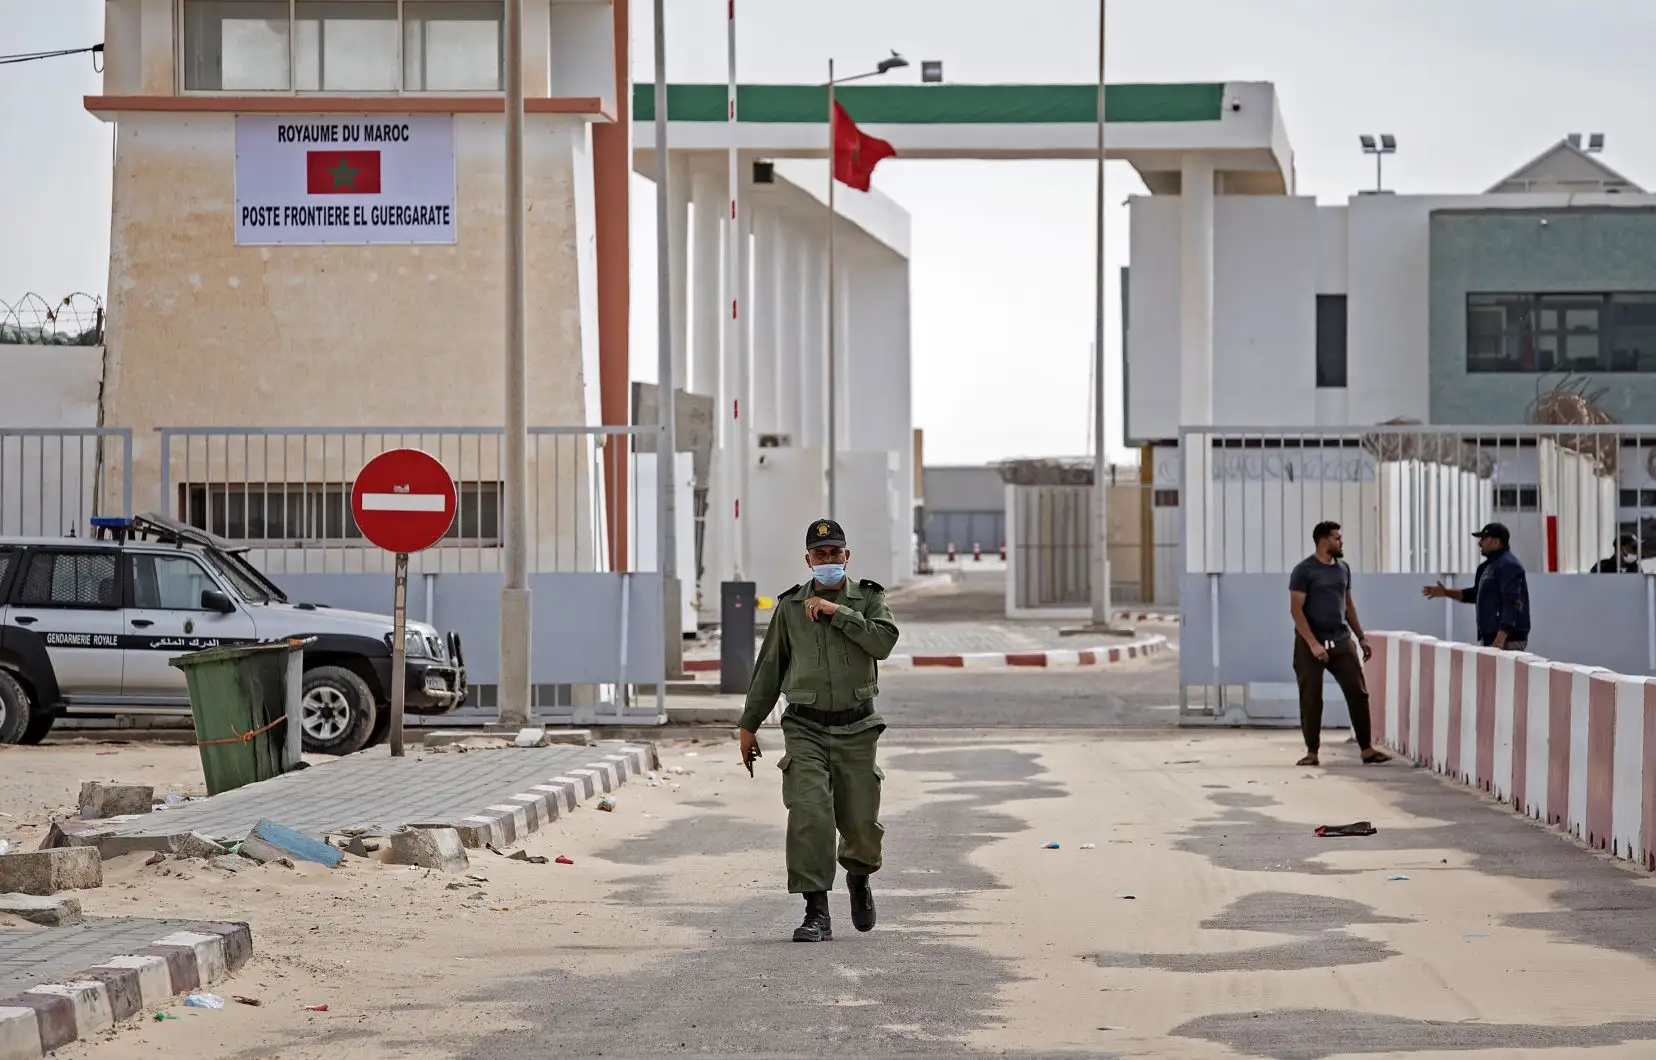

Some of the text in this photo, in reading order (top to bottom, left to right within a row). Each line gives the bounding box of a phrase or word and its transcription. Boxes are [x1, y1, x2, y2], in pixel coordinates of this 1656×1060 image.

[278, 124, 410, 143] ROYAUME DU MAROC
[242, 205, 450, 226] POSTE FRONTIERE EL GUERGARATE
[47, 632, 118, 646] GENDARMERIE ROYALE
[150, 637, 185, 648] الملكي
[189, 638, 220, 648] الدرك
